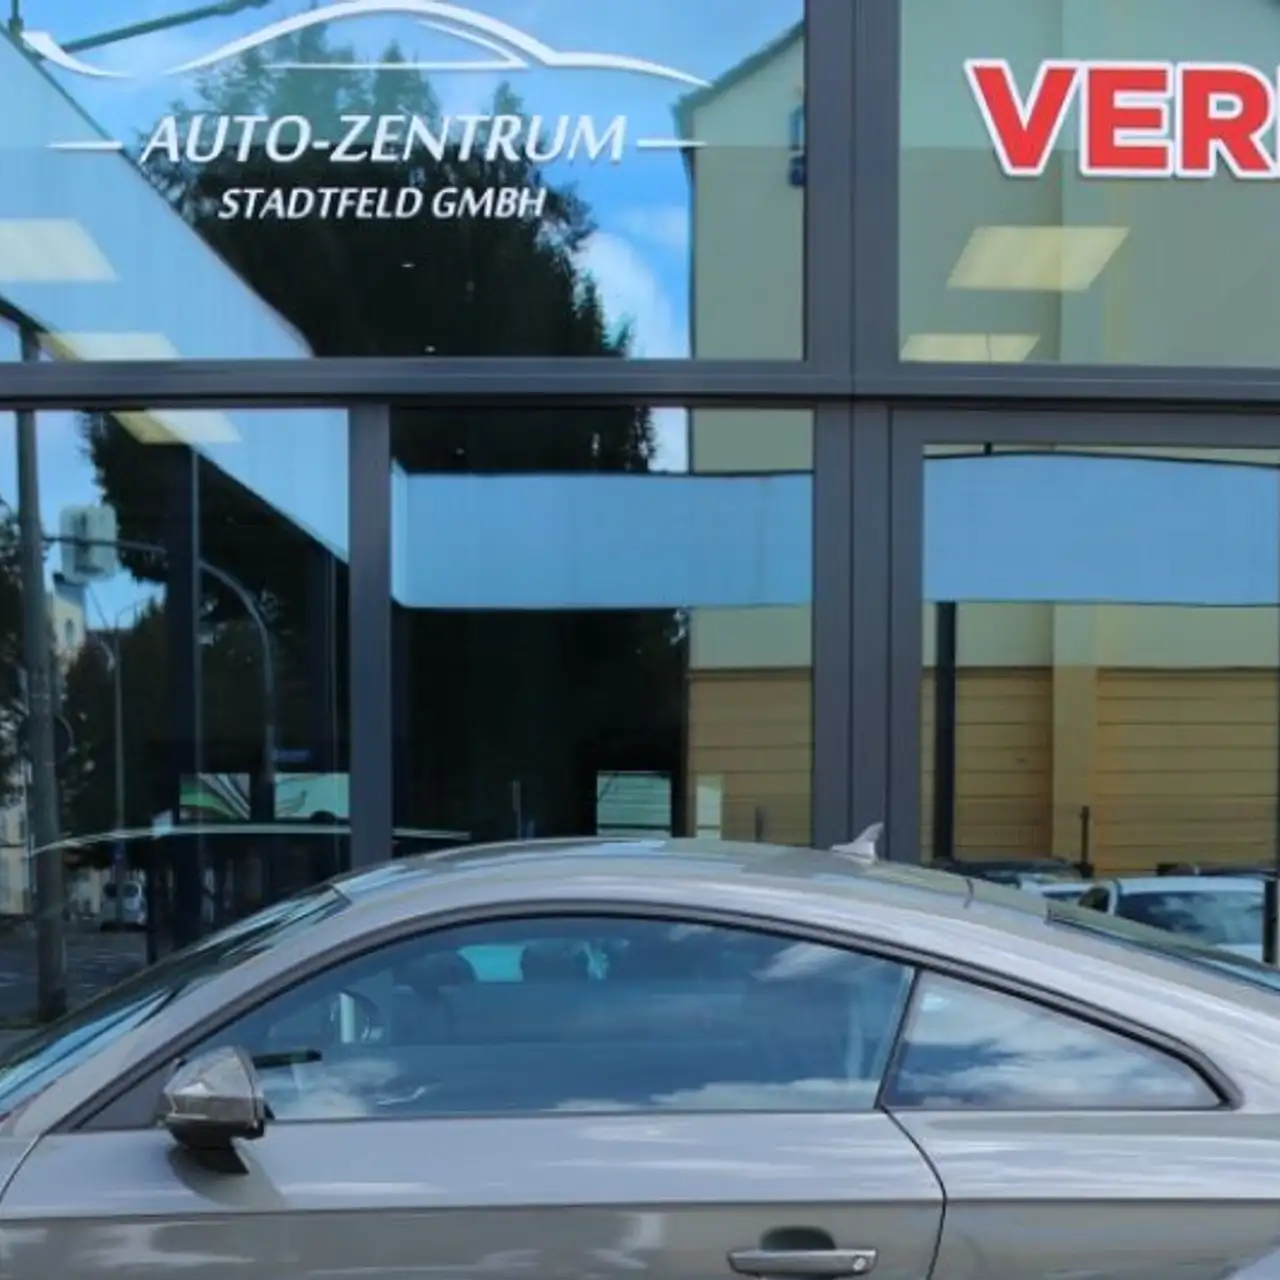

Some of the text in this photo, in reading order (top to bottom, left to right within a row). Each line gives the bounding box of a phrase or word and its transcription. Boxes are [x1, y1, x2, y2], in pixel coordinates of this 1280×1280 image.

[140, 114, 627, 166] AUTO-ZENTRUM
[218, 187, 546, 220] STADTFELD GMBH
